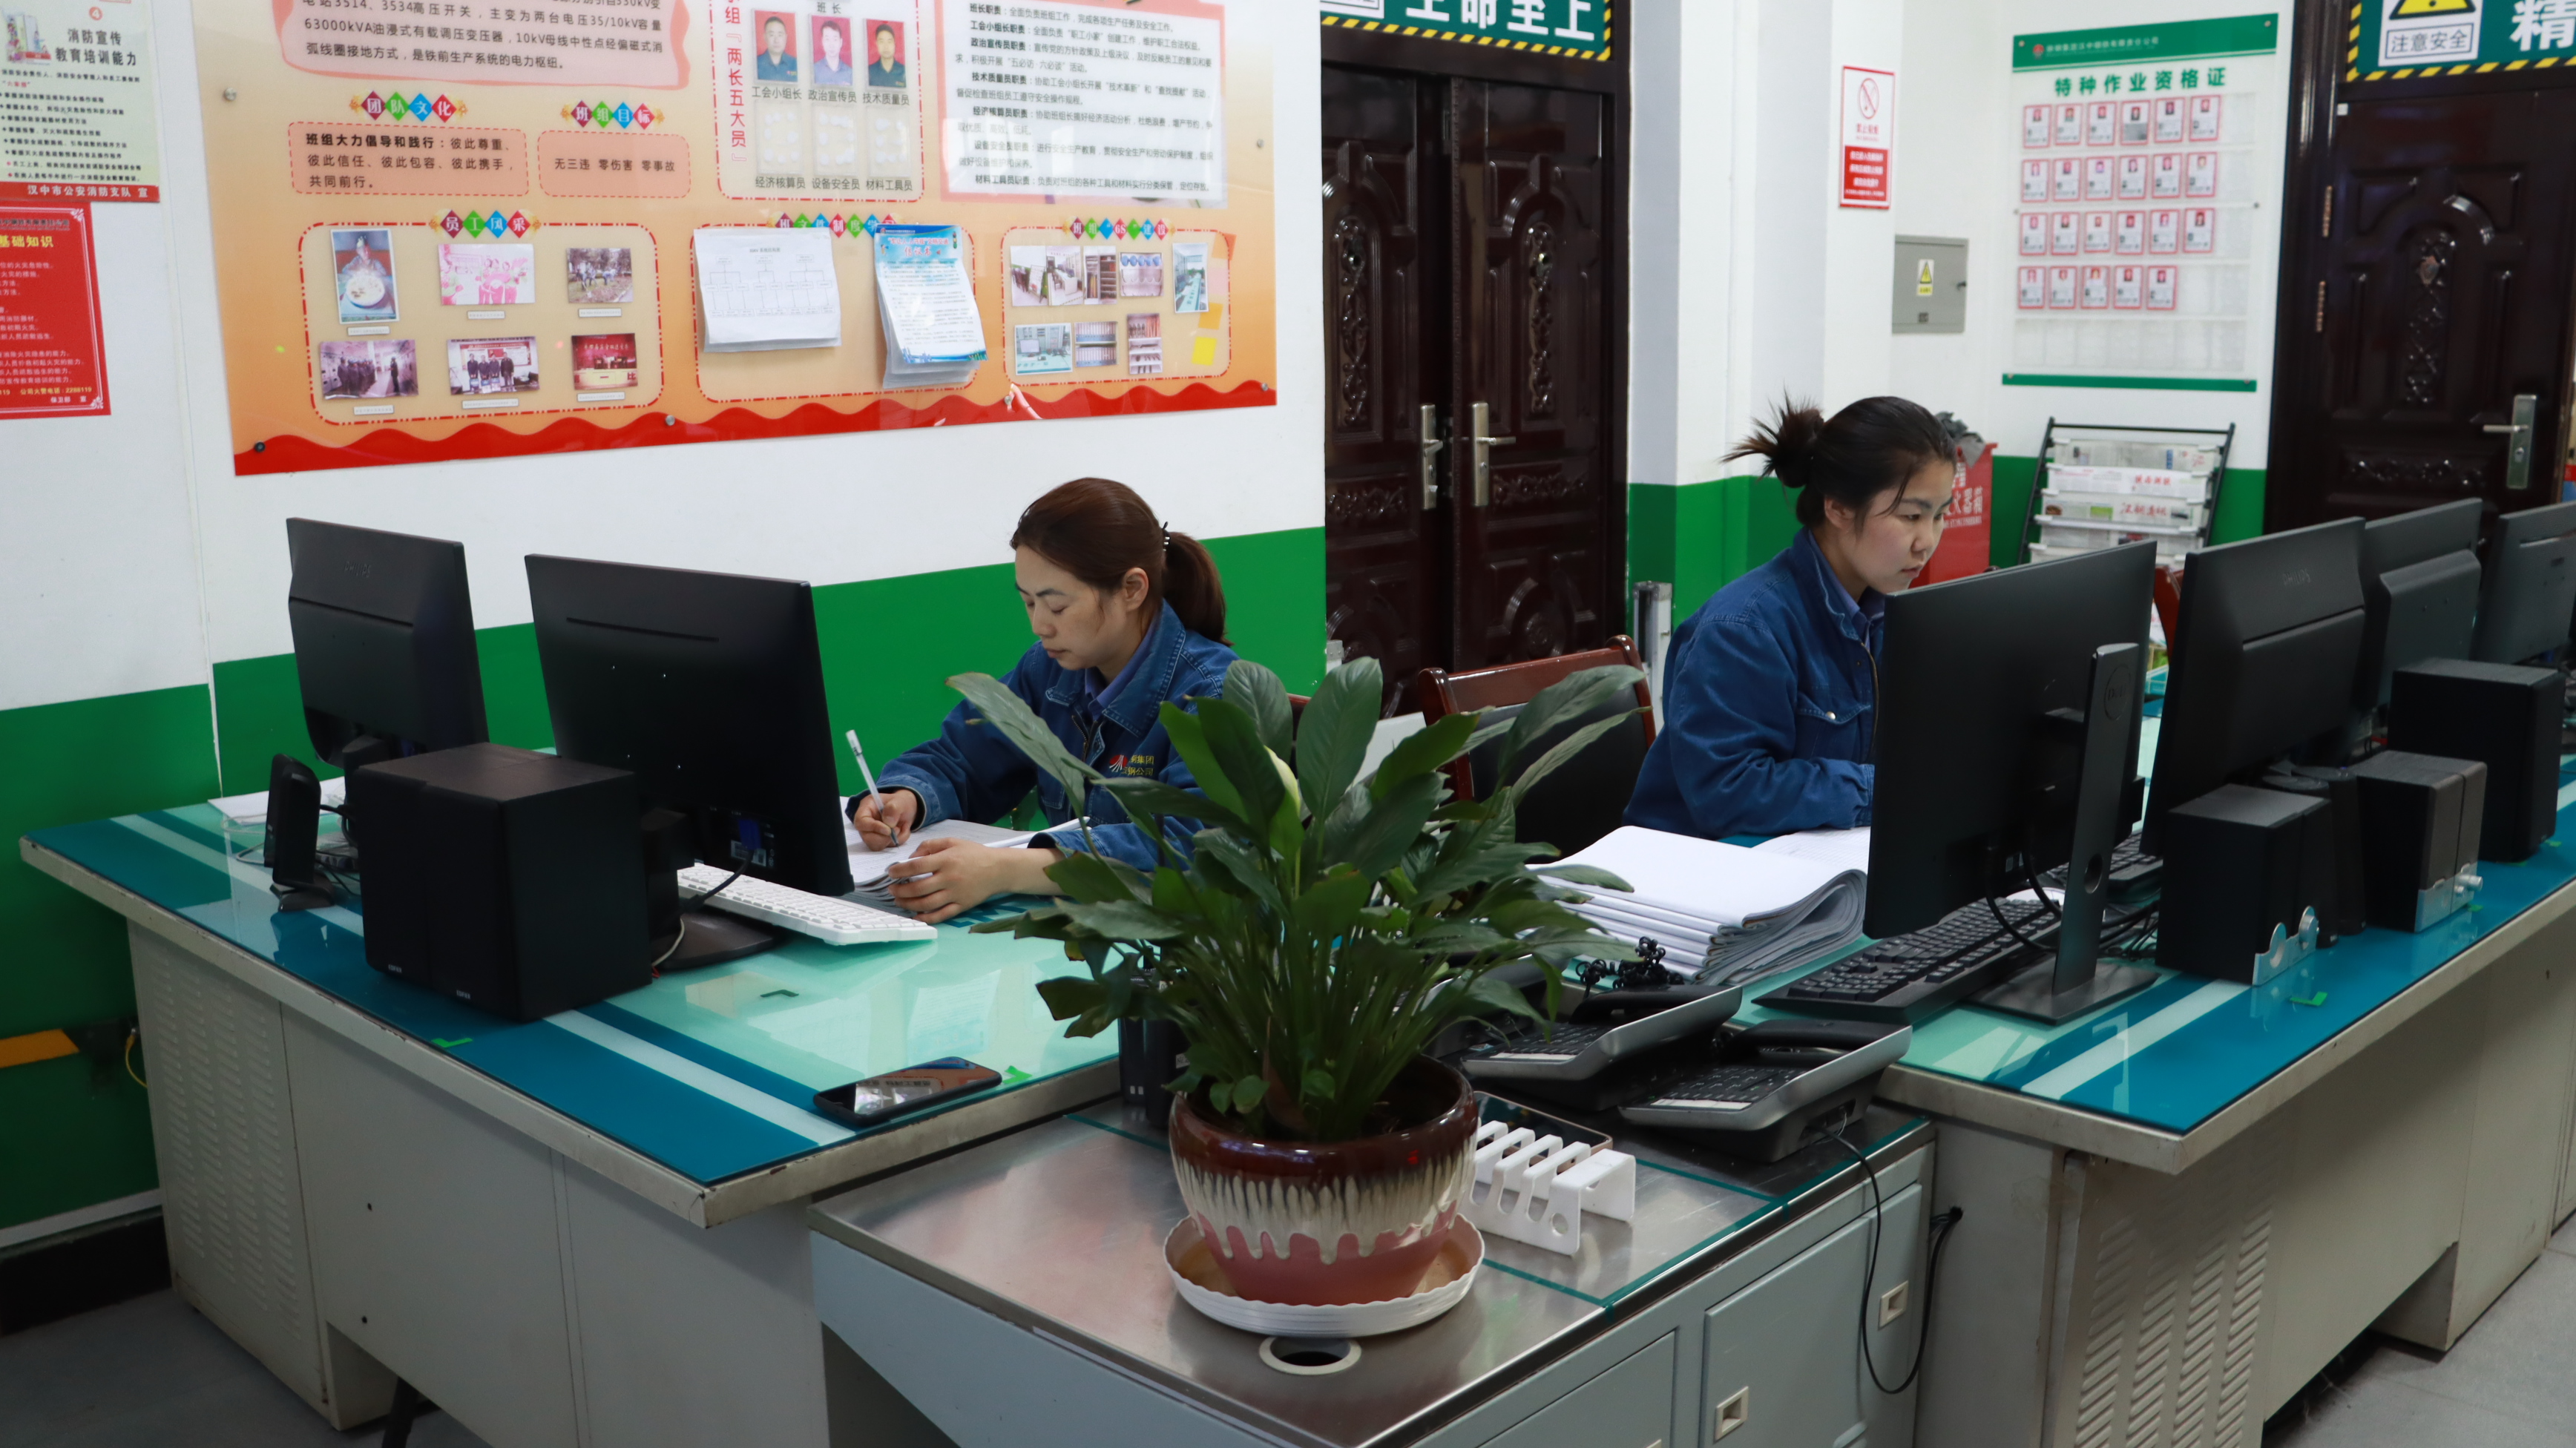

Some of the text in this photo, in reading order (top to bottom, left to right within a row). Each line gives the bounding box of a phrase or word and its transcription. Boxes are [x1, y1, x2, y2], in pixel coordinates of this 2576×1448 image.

[68, 28, 122, 46] 消防宣传
[2391, 29, 2468, 53] 注意安全
[56, 47, 137, 66] 教育培训能力
[2054, 67, 2227, 97] 特种作业资格证
[752, 86, 802, 99] 工会小组长
[808, 89, 857, 103] 政治宣传员
[862, 93, 910, 106] 技术质量员
[367, 98, 452, 116] 团队文化
[576, 106, 651, 124] 班组目标
[555, 157, 676, 172] 无三违 零伤害 零事故
[309, 175, 373, 188] 共同前行。
[755, 177, 806, 189] 经济核算员
[812, 178, 861, 191] 设备安全员
[866, 180, 913, 191] 材料工具员
[27, 184, 148, 198] 汉中市公安消防支队 宣
[446, 216, 526, 232] 员工风采
